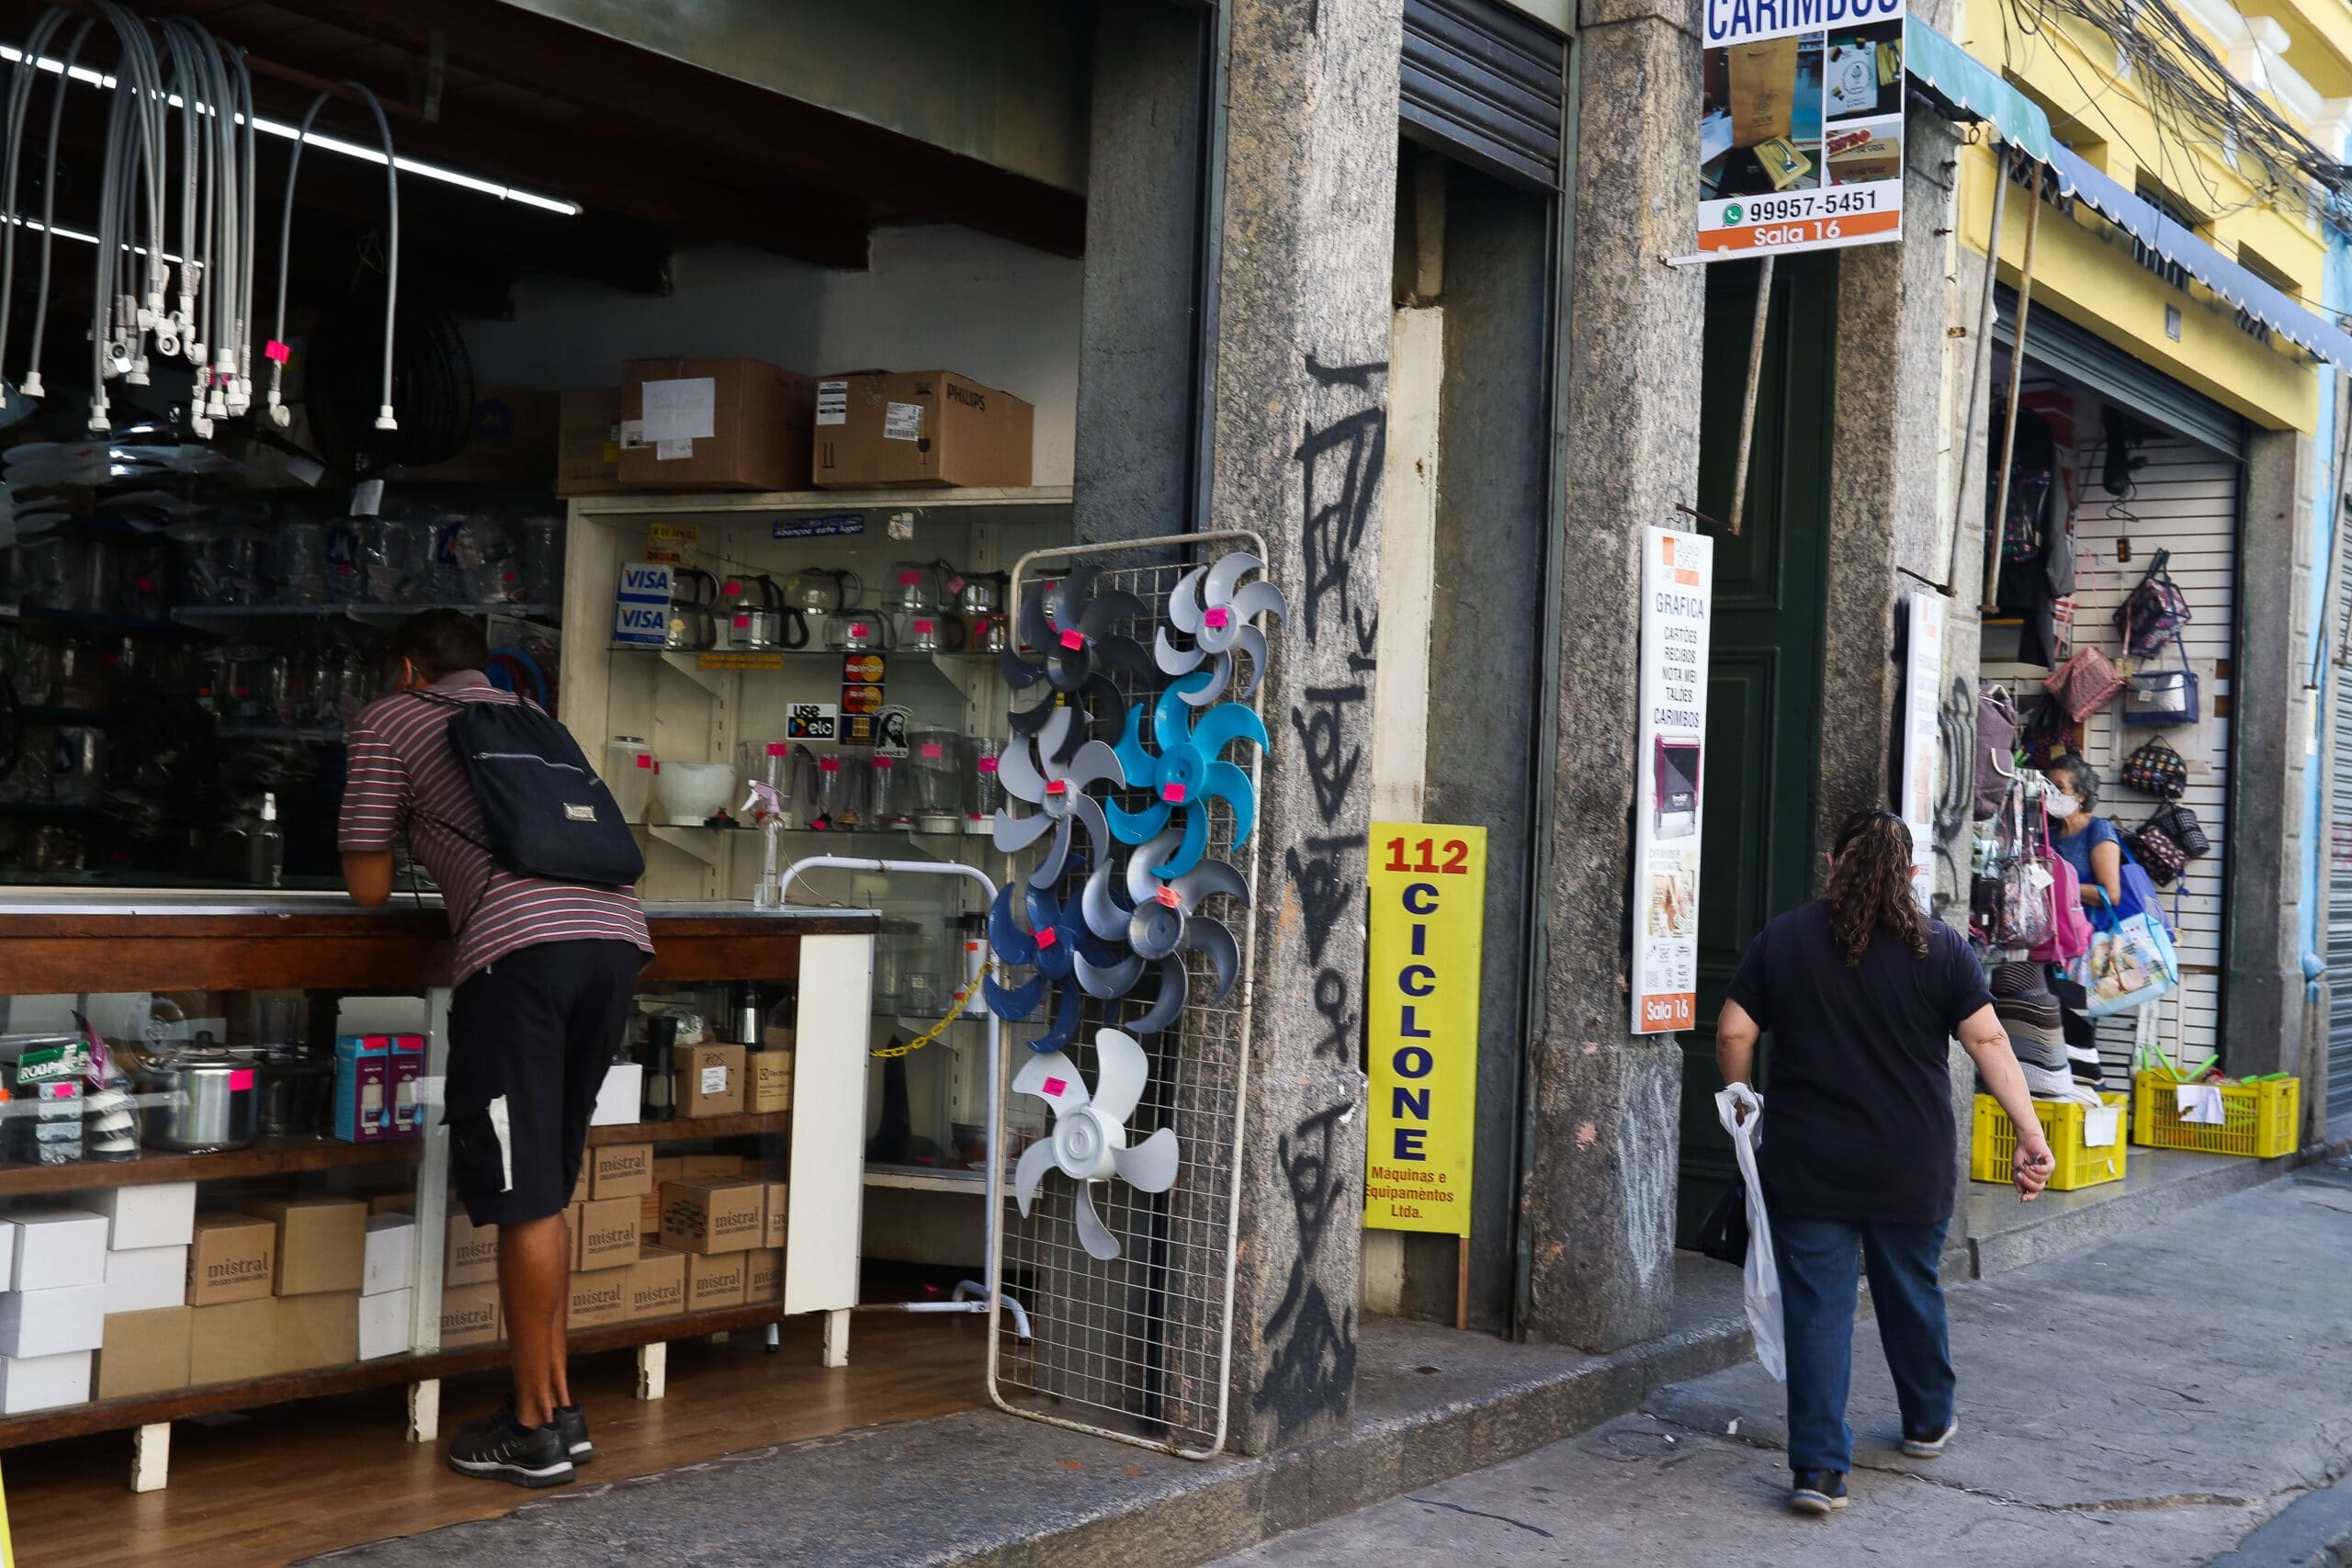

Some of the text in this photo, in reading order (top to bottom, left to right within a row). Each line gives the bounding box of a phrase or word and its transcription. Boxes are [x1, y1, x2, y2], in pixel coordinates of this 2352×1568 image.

[1708, 0, 1897, 40] CARIM
[1750, 189, 1876, 222] 99957-5451
[1754, 220, 1841, 246] Sala 16
[947, 382, 986, 412] PHILIPS
[624, 569, 669, 591] VISA
[620, 608, 664, 629] VISA
[1664, 646, 1697, 664] RECIBOS
[1662, 666, 1683, 682] NOTA
[793, 705, 820, 719] use
[1654, 707, 1700, 728] CARIMBOS
[808, 719, 833, 735] elo
[1385, 837, 1469, 874] 112
[1646, 998, 1689, 1021] Sala 16
[1392, 882, 1440, 1162] CICLONE
[599, 1150, 646, 1172] mistral
[1438, 1173, 1447, 1183] e
[715, 1206, 759, 1228] mistral
[1391, 1203, 1423, 1219] Ltda.
[588, 1222, 636, 1246] mistral
[456, 1239, 499, 1259] mistra
[208, 1251, 267, 1278] mistral
[696, 1268, 741, 1290] mistral
[572, 1283, 620, 1306] mistral
[634, 1280, 682, 1304] mistral
[440, 1303, 493, 1327] mistral
